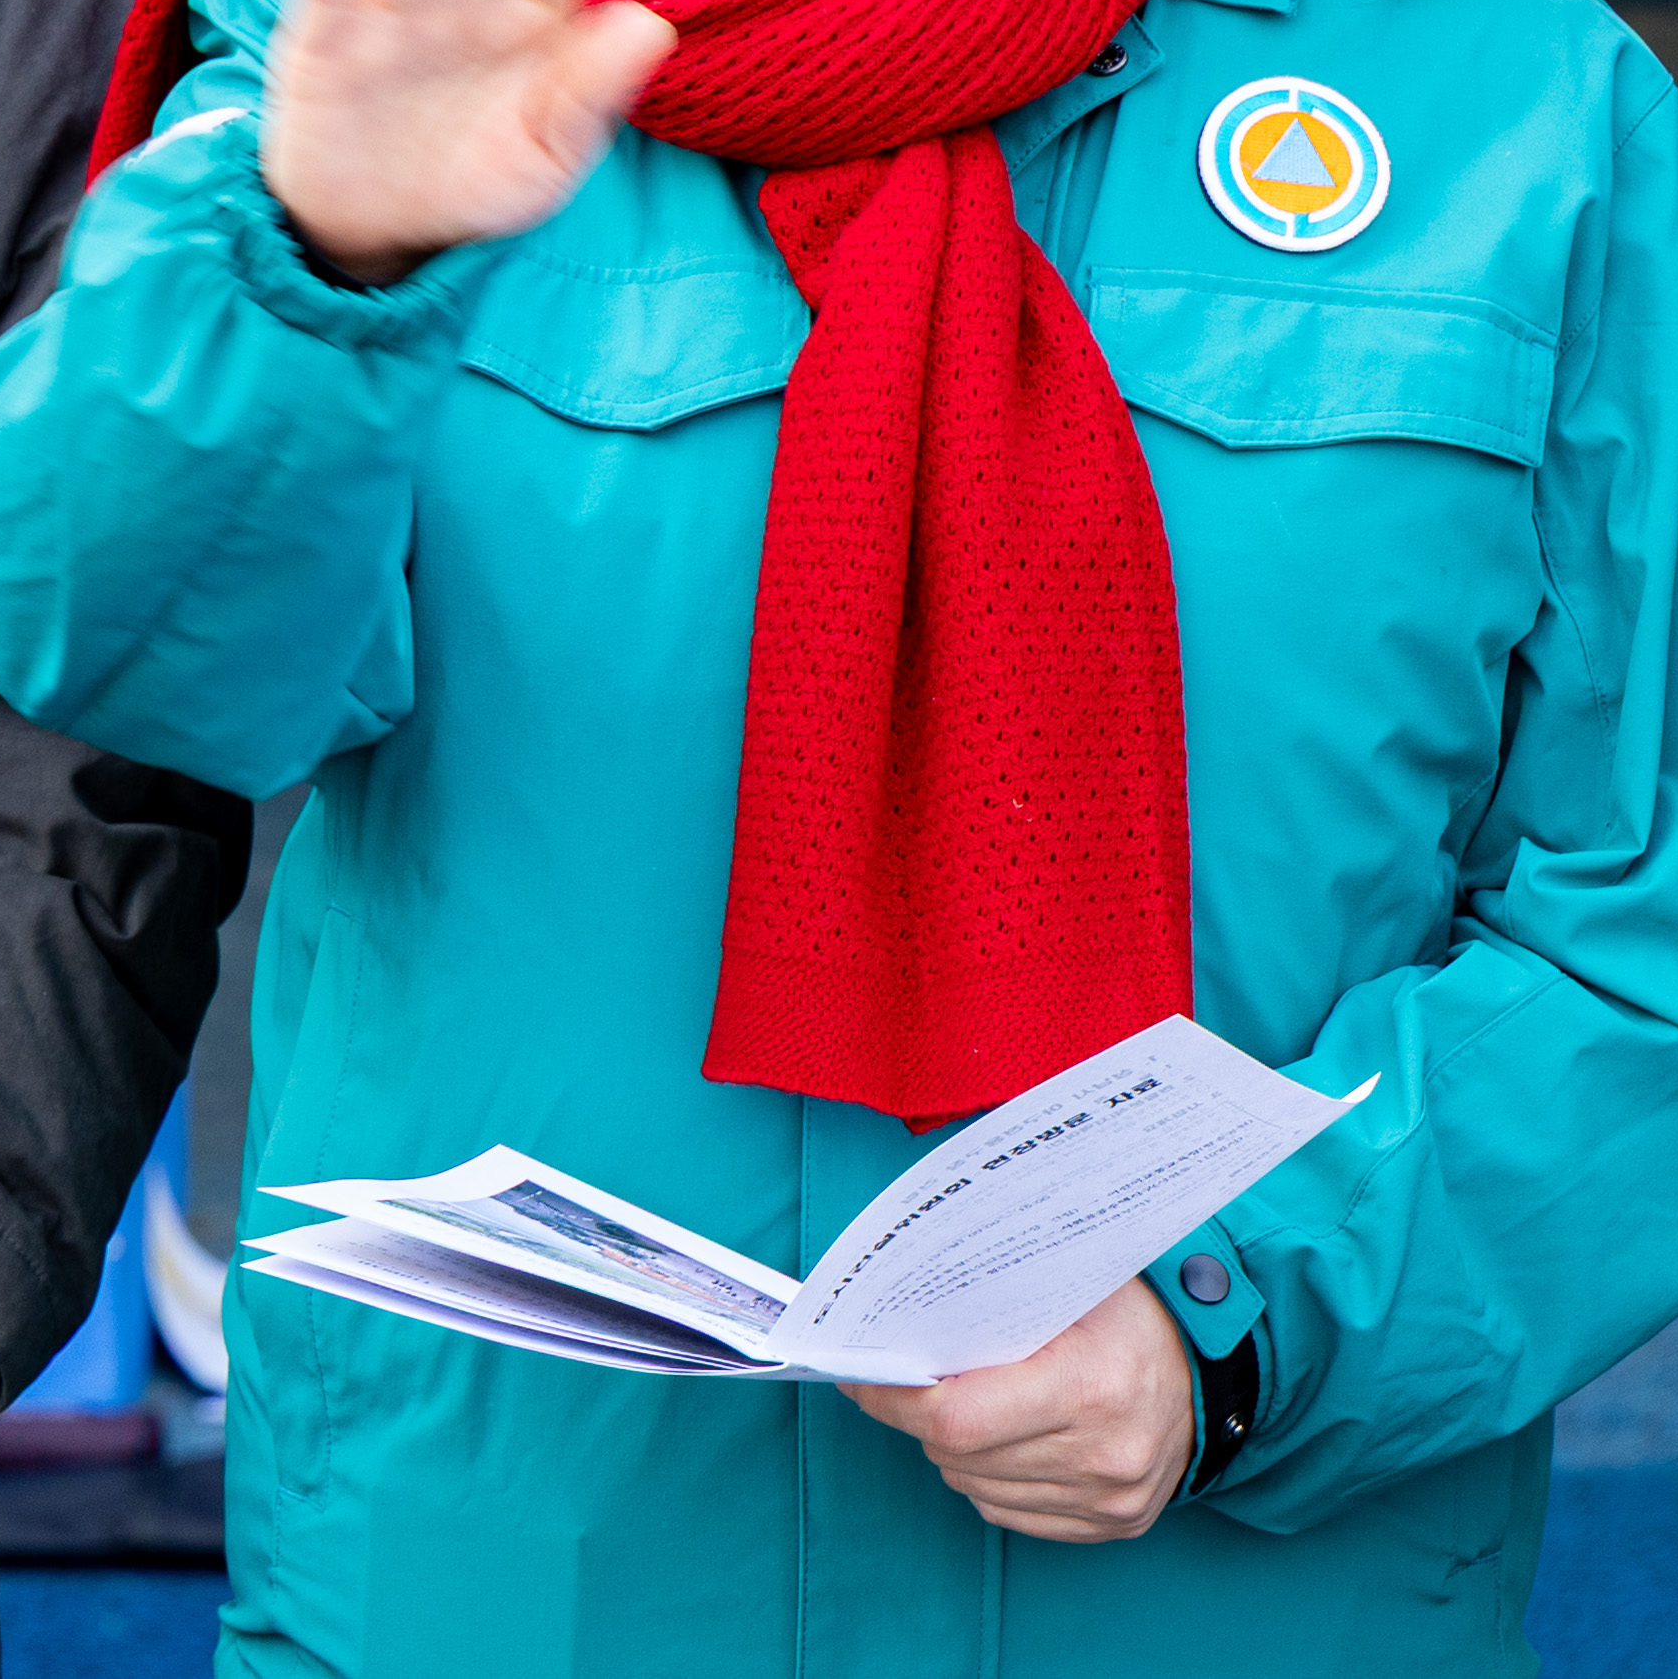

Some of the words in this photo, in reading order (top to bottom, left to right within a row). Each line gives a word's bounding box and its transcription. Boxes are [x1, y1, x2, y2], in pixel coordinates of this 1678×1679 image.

[813, 1178, 971, 1325] 도시건설위원회
[981, 1112, 1093, 1170] 현장방문
[1102, 1077, 1163, 1110] 자료
